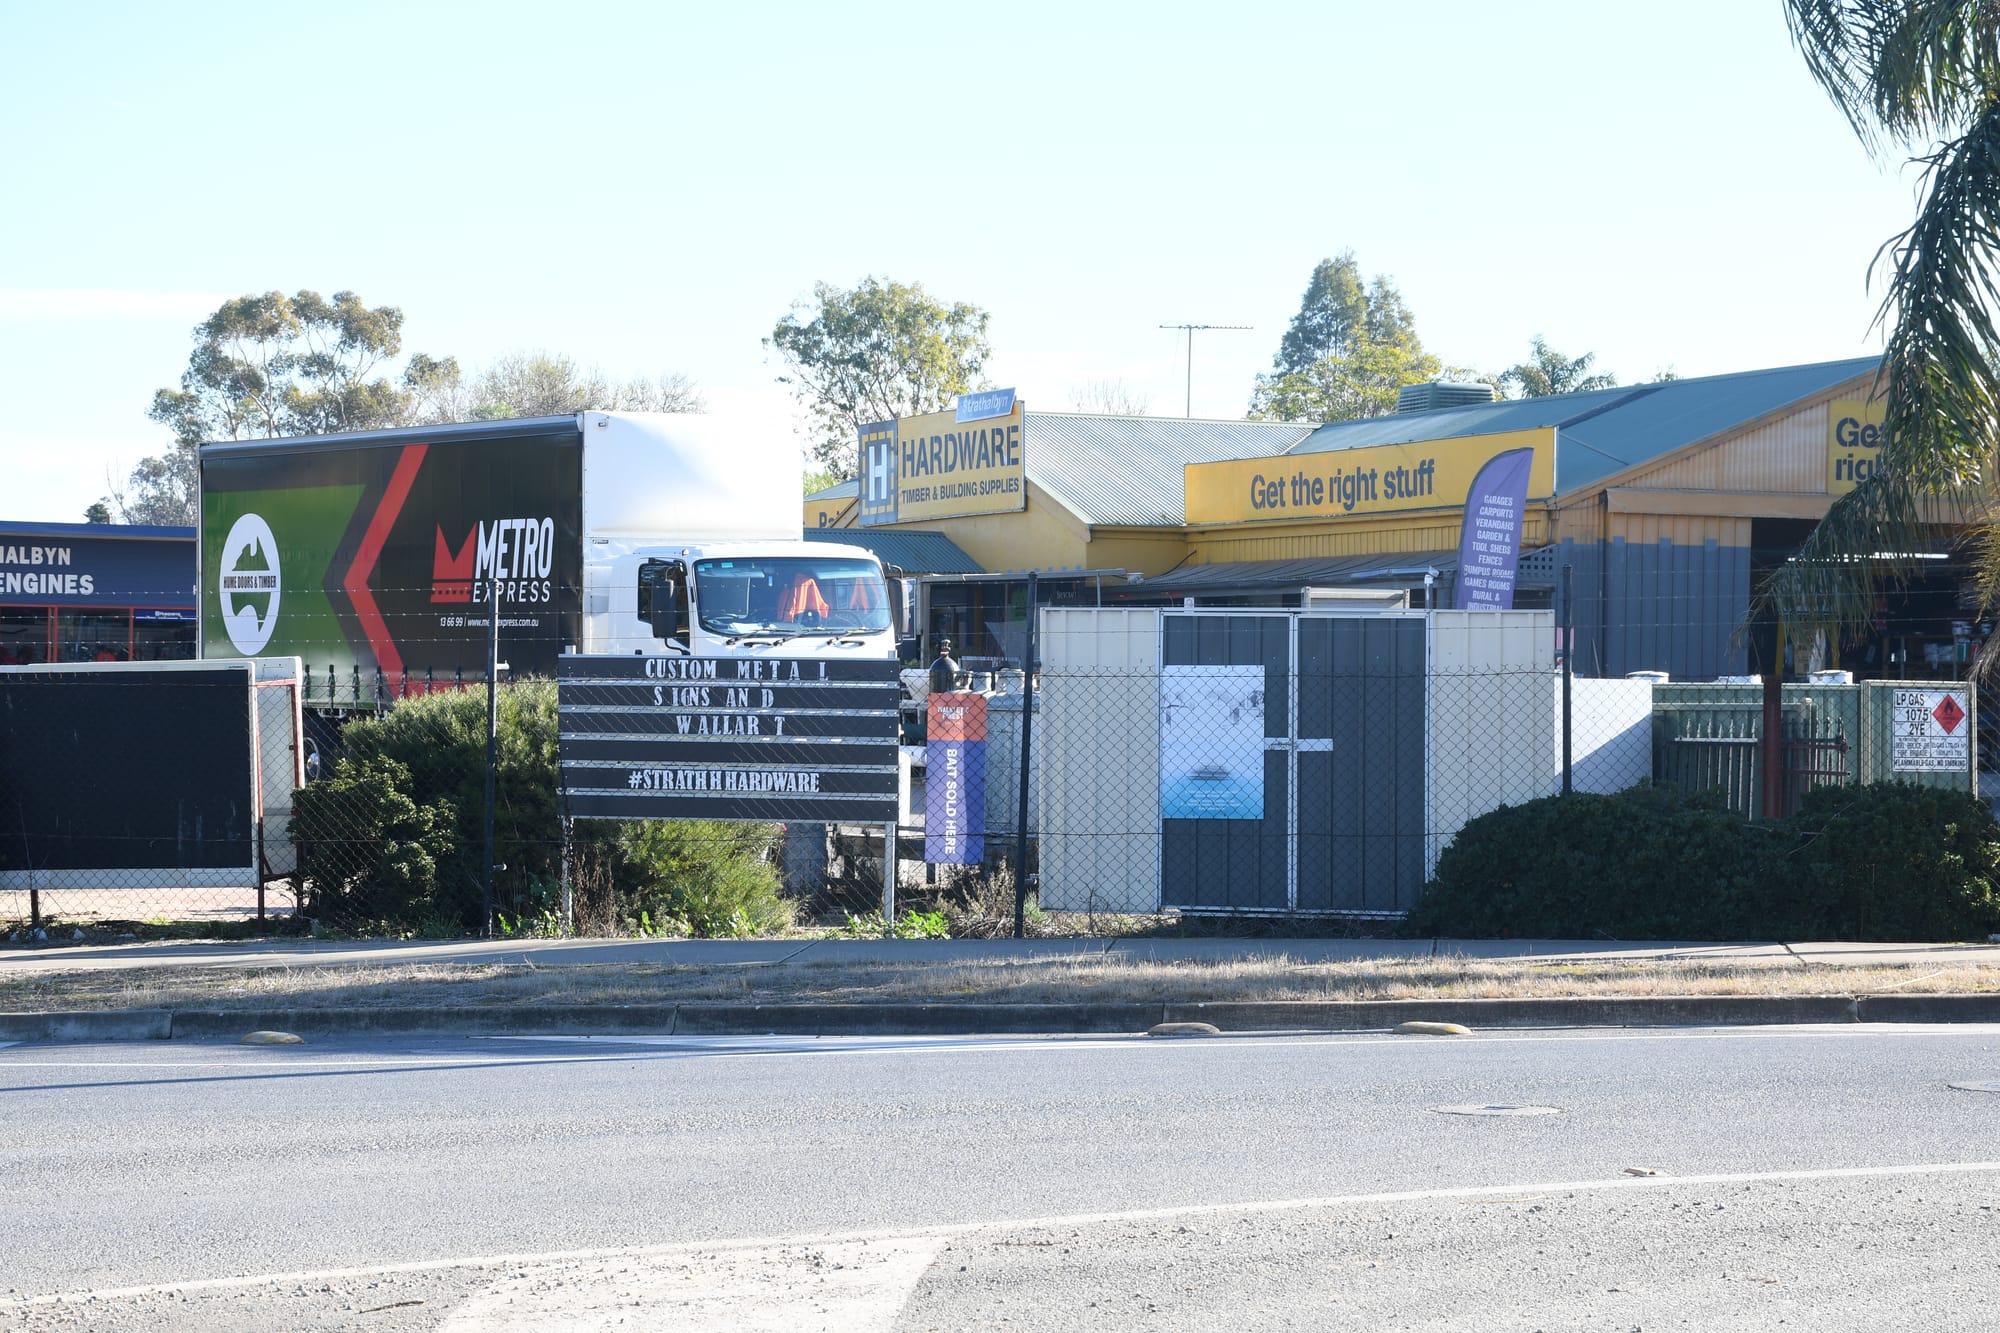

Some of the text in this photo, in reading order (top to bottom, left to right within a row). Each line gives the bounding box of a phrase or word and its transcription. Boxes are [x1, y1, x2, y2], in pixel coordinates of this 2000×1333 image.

[902, 425, 1019, 479] HARDWARE
[902, 477, 1019, 504] TIMBER & BUILDING SUPPLIES
[1251, 458, 1435, 511] Get the right stuff
[1484, 495, 1513, 506] GARAGES
[1479, 507, 1514, 518] CARPORTS
[1475, 518, 1514, 530] VERANDAHS
[1477, 530, 1511, 543] GARDEN &
[475, 517, 555, 579] METRO
[1472, 542, 1511, 554] TOOL SHEDS
[0, 546, 71, 565] ALBYN
[1478, 555, 1503, 566] FENCES
[1492, 569, 1514, 579] ROOMS
[1464, 578, 1511, 591] GAMES ROOMS
[472, 581, 551, 603] EXPRESS
[1472, 591, 1500, 601] RURAL &
[440, 617, 447, 627] 13
[447, 617, 455, 627] 66
[455, 617, 464, 627] 99
[645, 659, 717, 680] CUSTOM
[1896, 693, 1925, 706] LP GAS
[1906, 709, 1929, 721] 1075
[1909, 723, 1925, 736] 2YE
[945, 749, 958, 855] BAIT SOLD HERE
